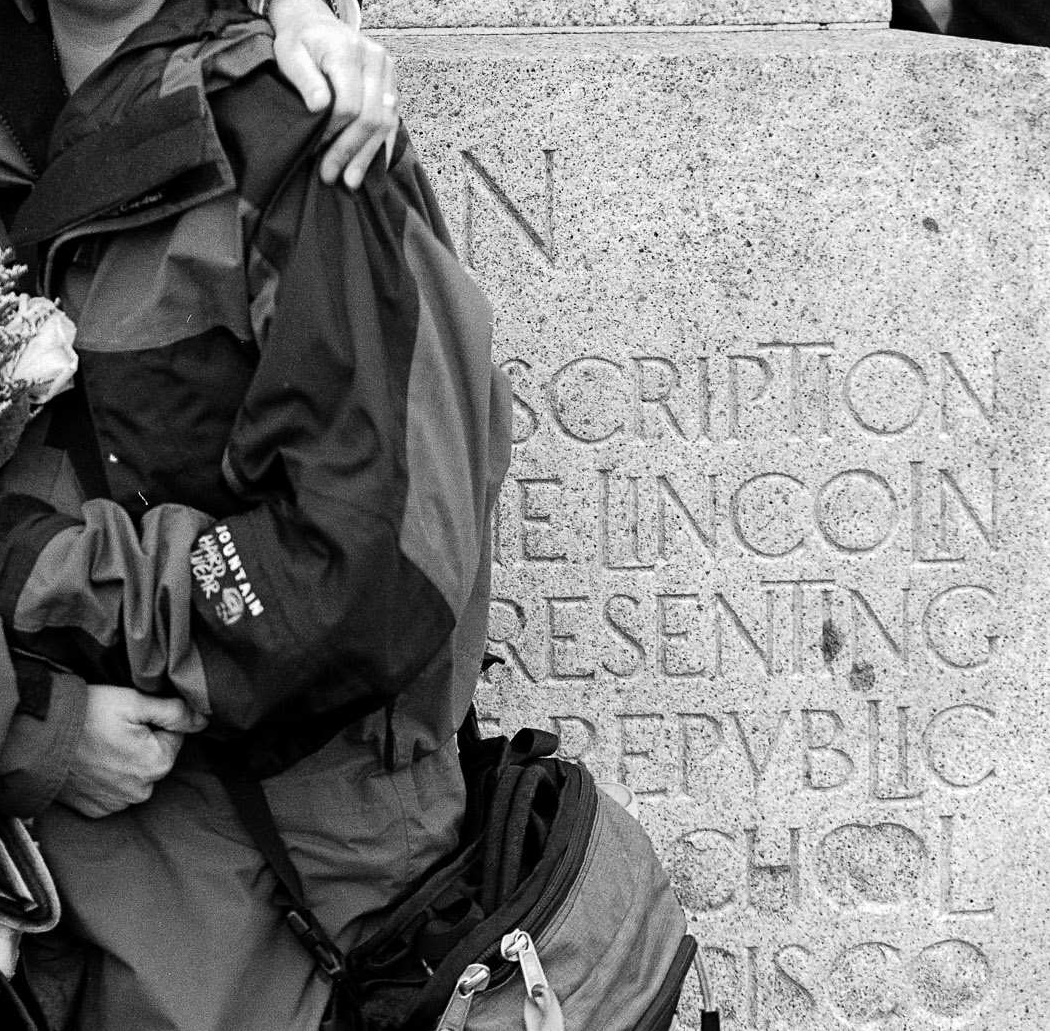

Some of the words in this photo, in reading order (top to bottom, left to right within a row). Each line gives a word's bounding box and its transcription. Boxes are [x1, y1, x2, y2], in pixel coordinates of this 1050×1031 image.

[499, 341, 1002, 445] SCRIPTION
[597, 460, 1000, 570] LINCOLN
[485, 579, 1001, 683] RESENTING
